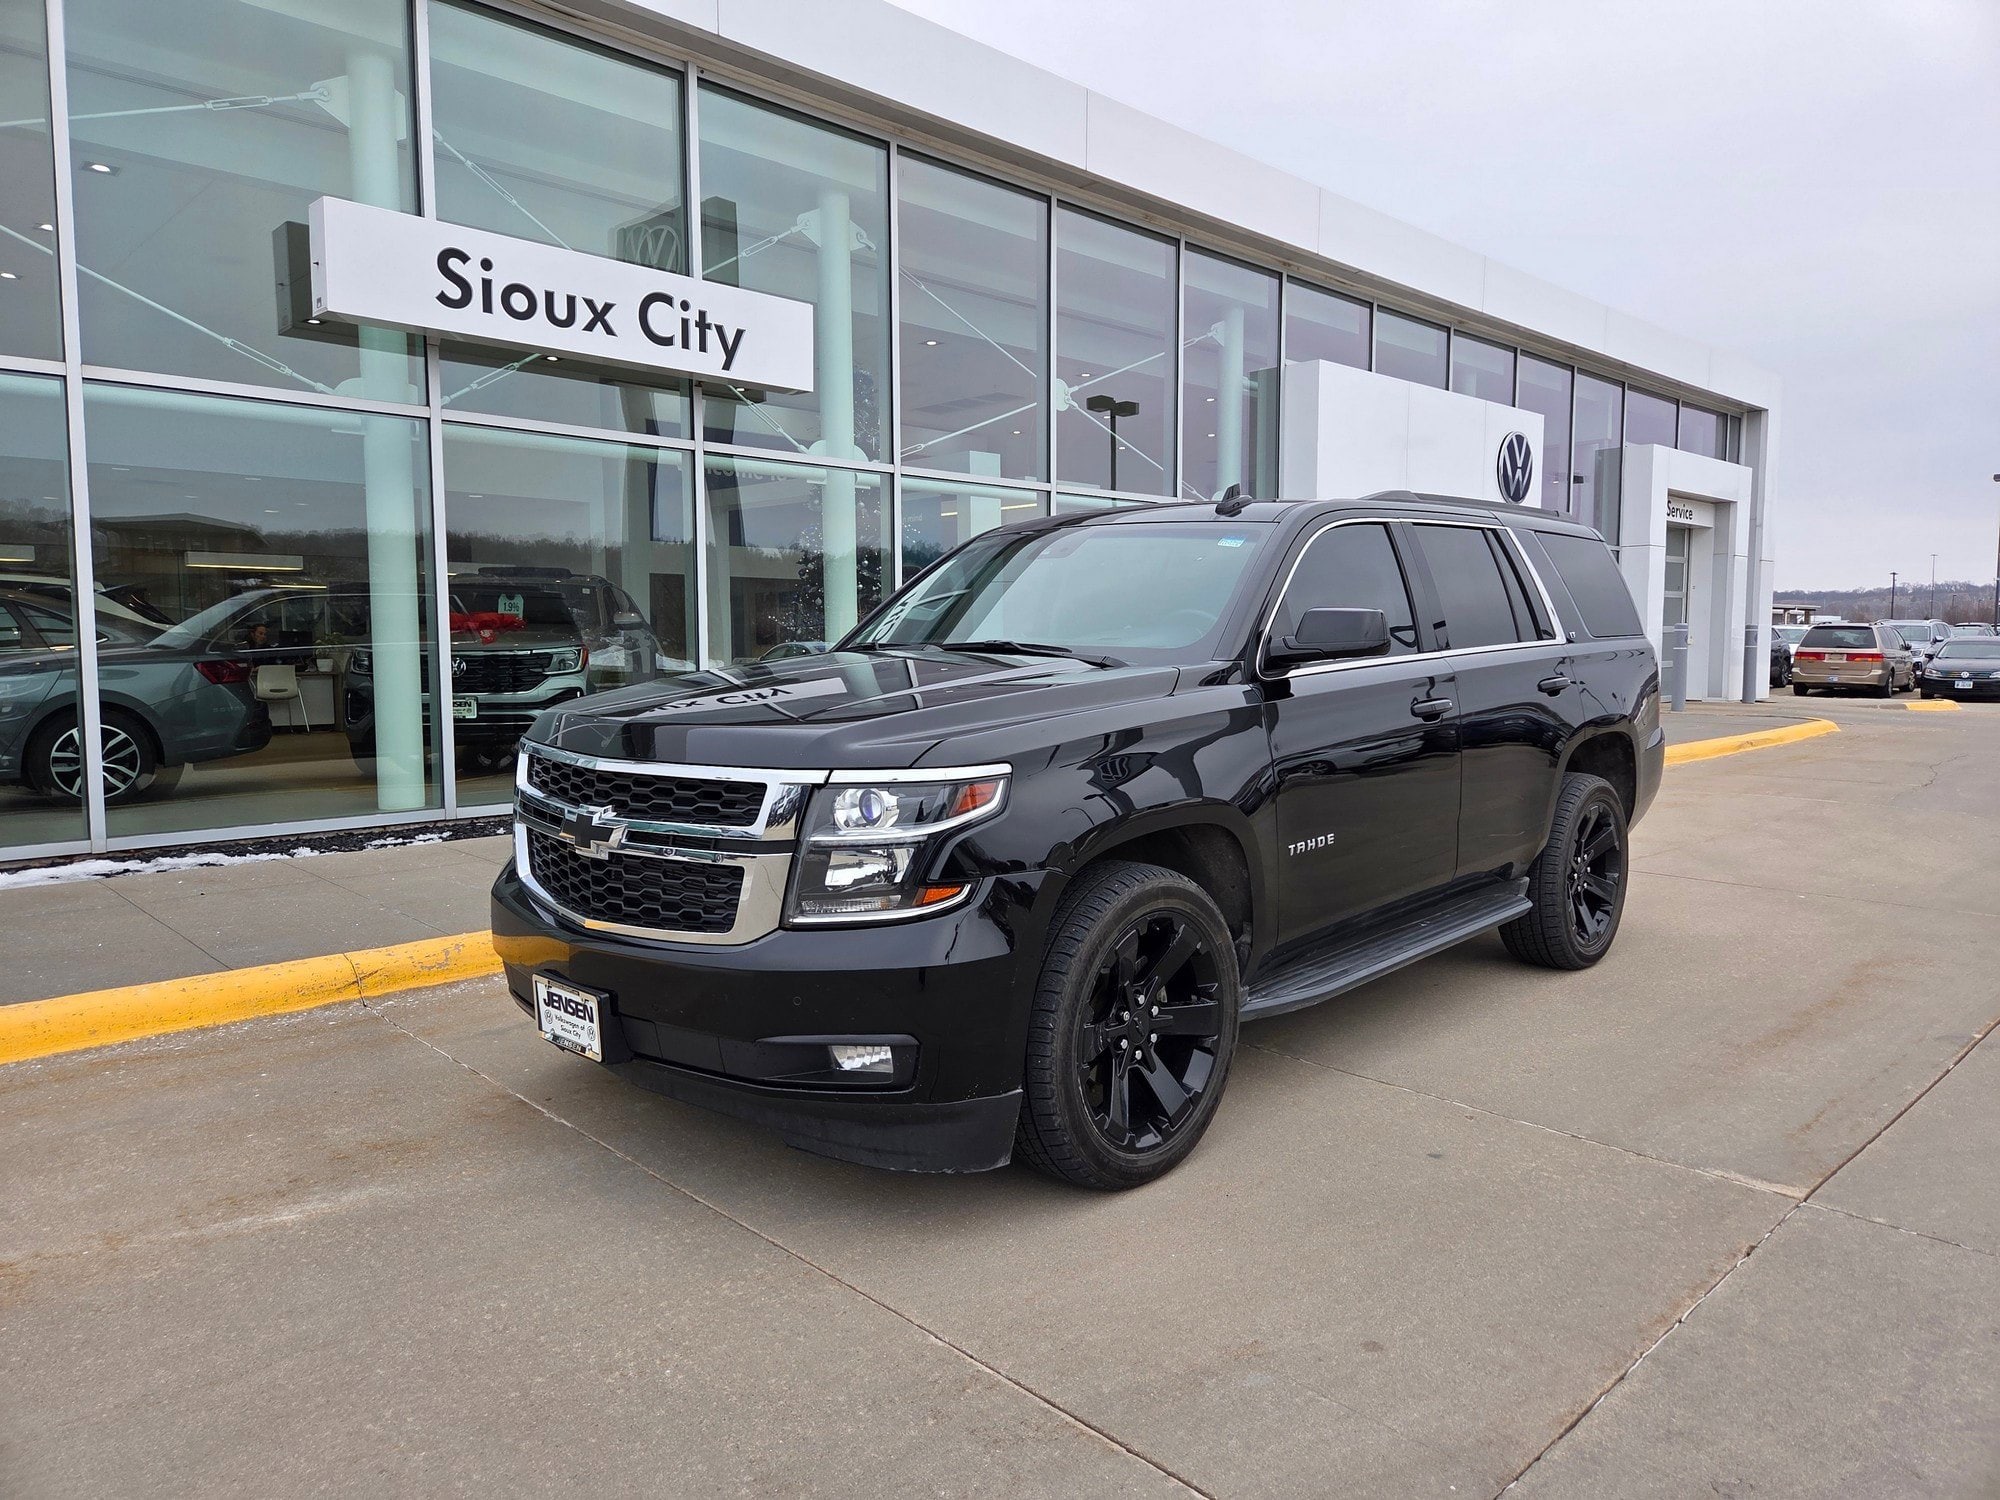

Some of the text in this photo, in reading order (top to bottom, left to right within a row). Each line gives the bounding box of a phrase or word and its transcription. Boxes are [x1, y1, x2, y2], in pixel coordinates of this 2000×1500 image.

[435, 246, 746, 371] Sioux City
[1666, 500, 1693, 520] Service
[1288, 833, 1335, 857] TAHOE
[543, 991, 595, 1024] JENSEN
[560, 1024, 572, 1035] Sioux
[556, 1037, 582, 1052] JENSEN
